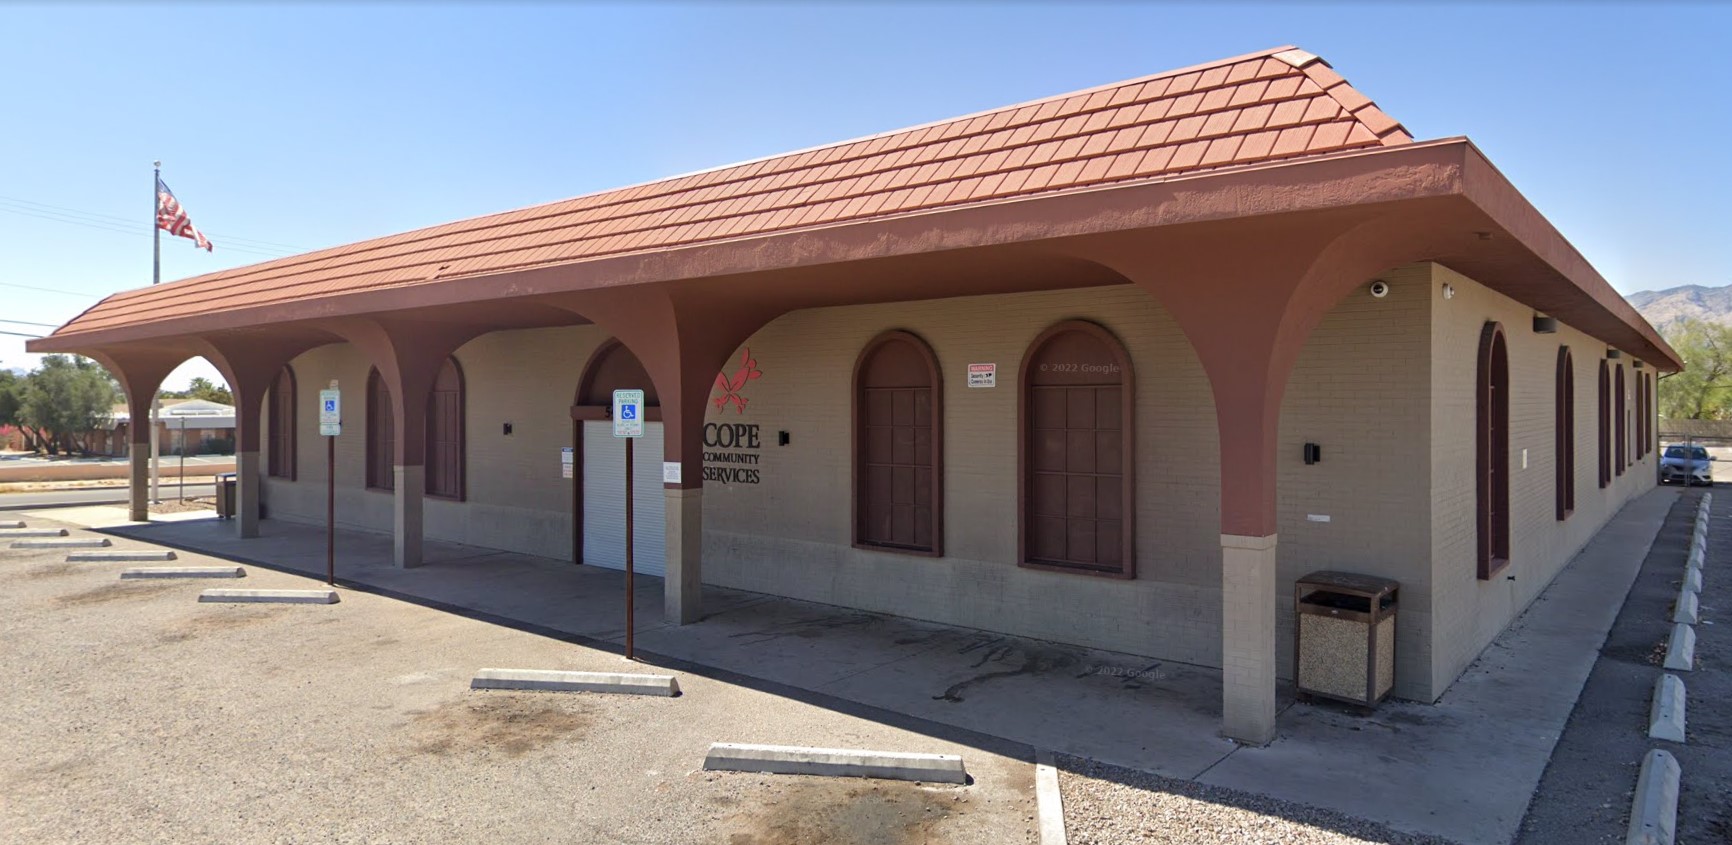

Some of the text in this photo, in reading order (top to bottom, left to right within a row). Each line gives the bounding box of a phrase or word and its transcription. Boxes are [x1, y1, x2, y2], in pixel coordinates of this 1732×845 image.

[703, 422, 760, 448] COPE
[703, 452, 760, 464] COMMUNITY
[703, 466, 760, 484] SERVICES
